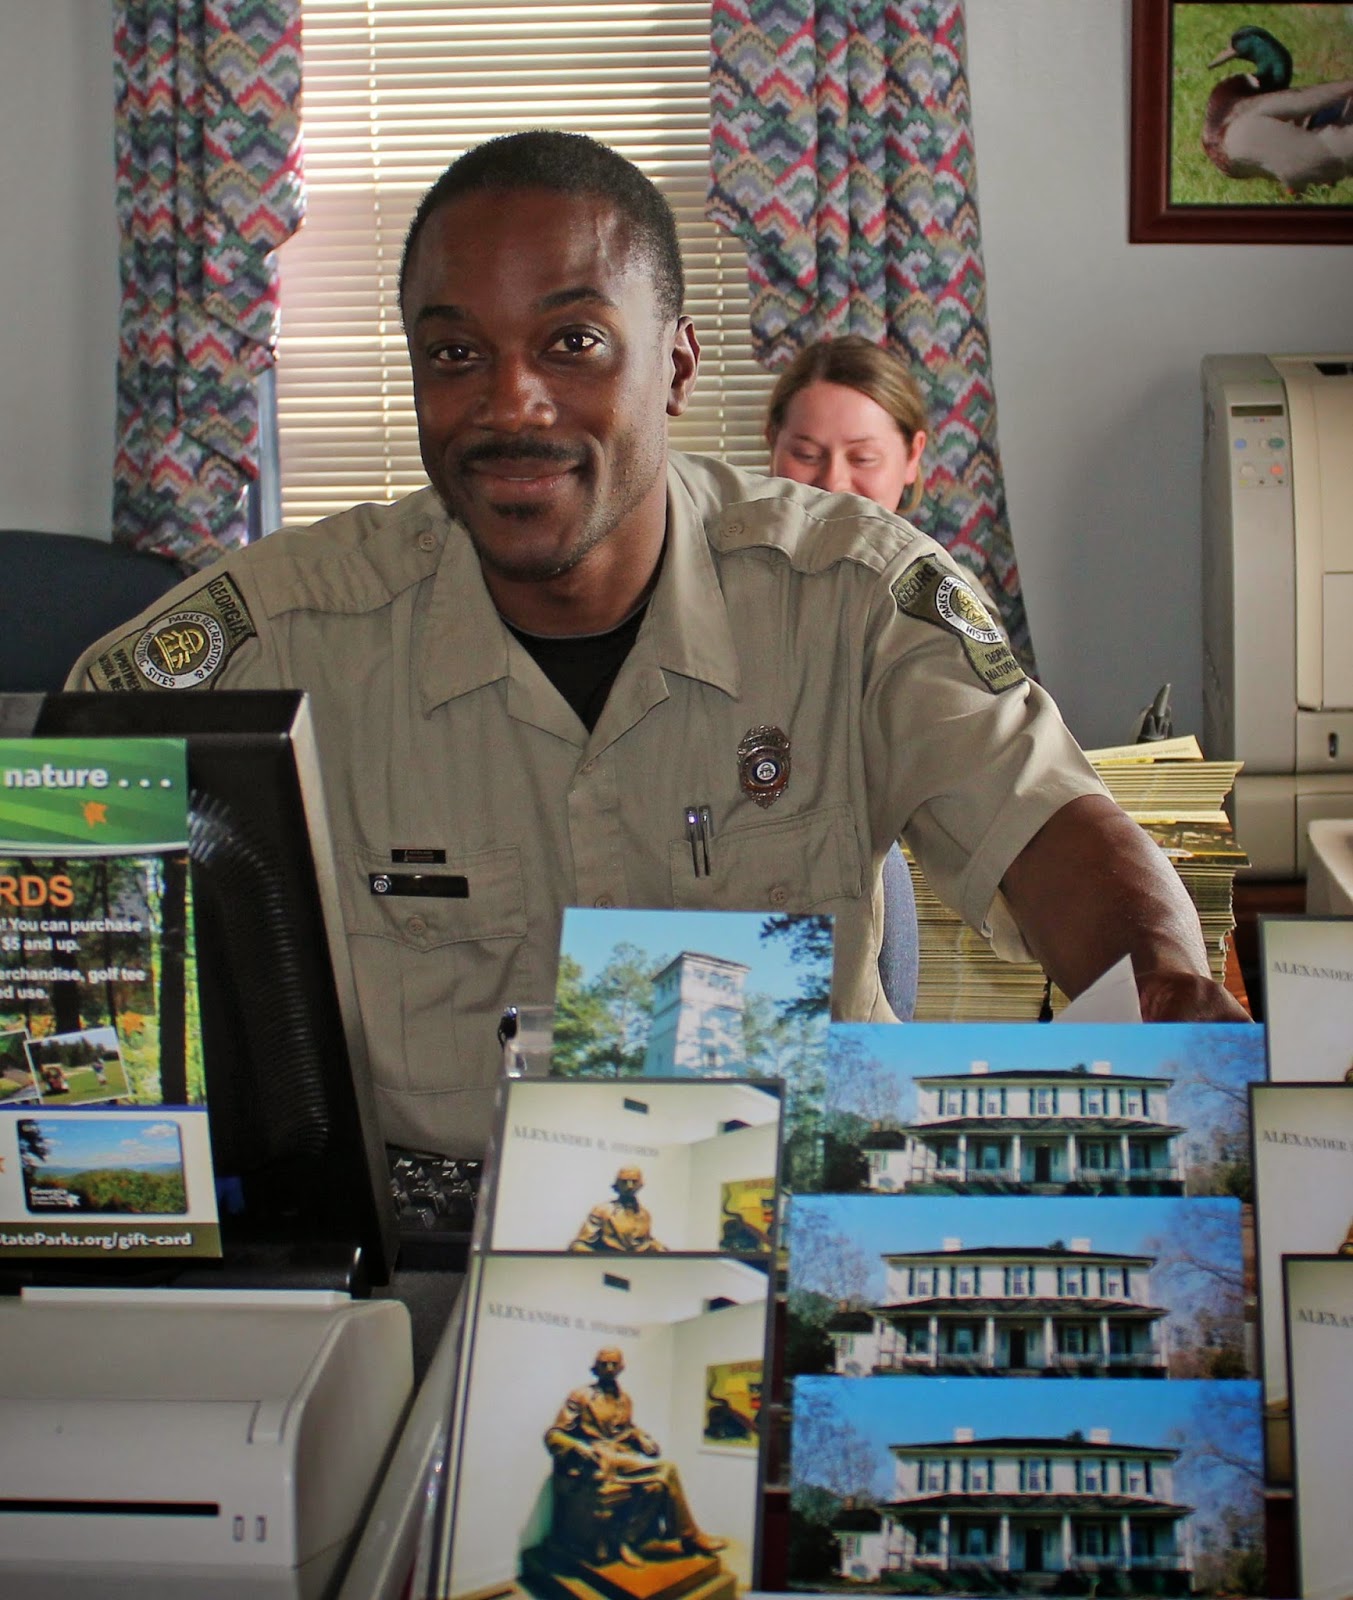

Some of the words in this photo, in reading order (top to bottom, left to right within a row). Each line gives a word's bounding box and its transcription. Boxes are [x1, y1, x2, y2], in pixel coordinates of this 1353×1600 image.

[207, 581, 248, 638] GEORGIA
[938, 593, 954, 619] PARKS
[168, 613, 202, 625] PARKS
[135, 631, 155, 668] HISTORIC
[201, 616, 224, 672] RECREATION
[145, 666, 176, 688] SITES
[4, 763, 109, 788] nature
[0, 874, 75, 907] RDS
[8, 917, 39, 932] You
[40, 920, 69, 932] can
[70, 919, 142, 935] purchase
[23, 936, 53, 951] and
[56, 939, 81, 954] up.
[88, 966, 118, 984] golf
[121, 968, 146, 981] tee
[17, 988, 50, 999] use.
[0, 1232, 192, 1249] tateParks.org/gift-card
